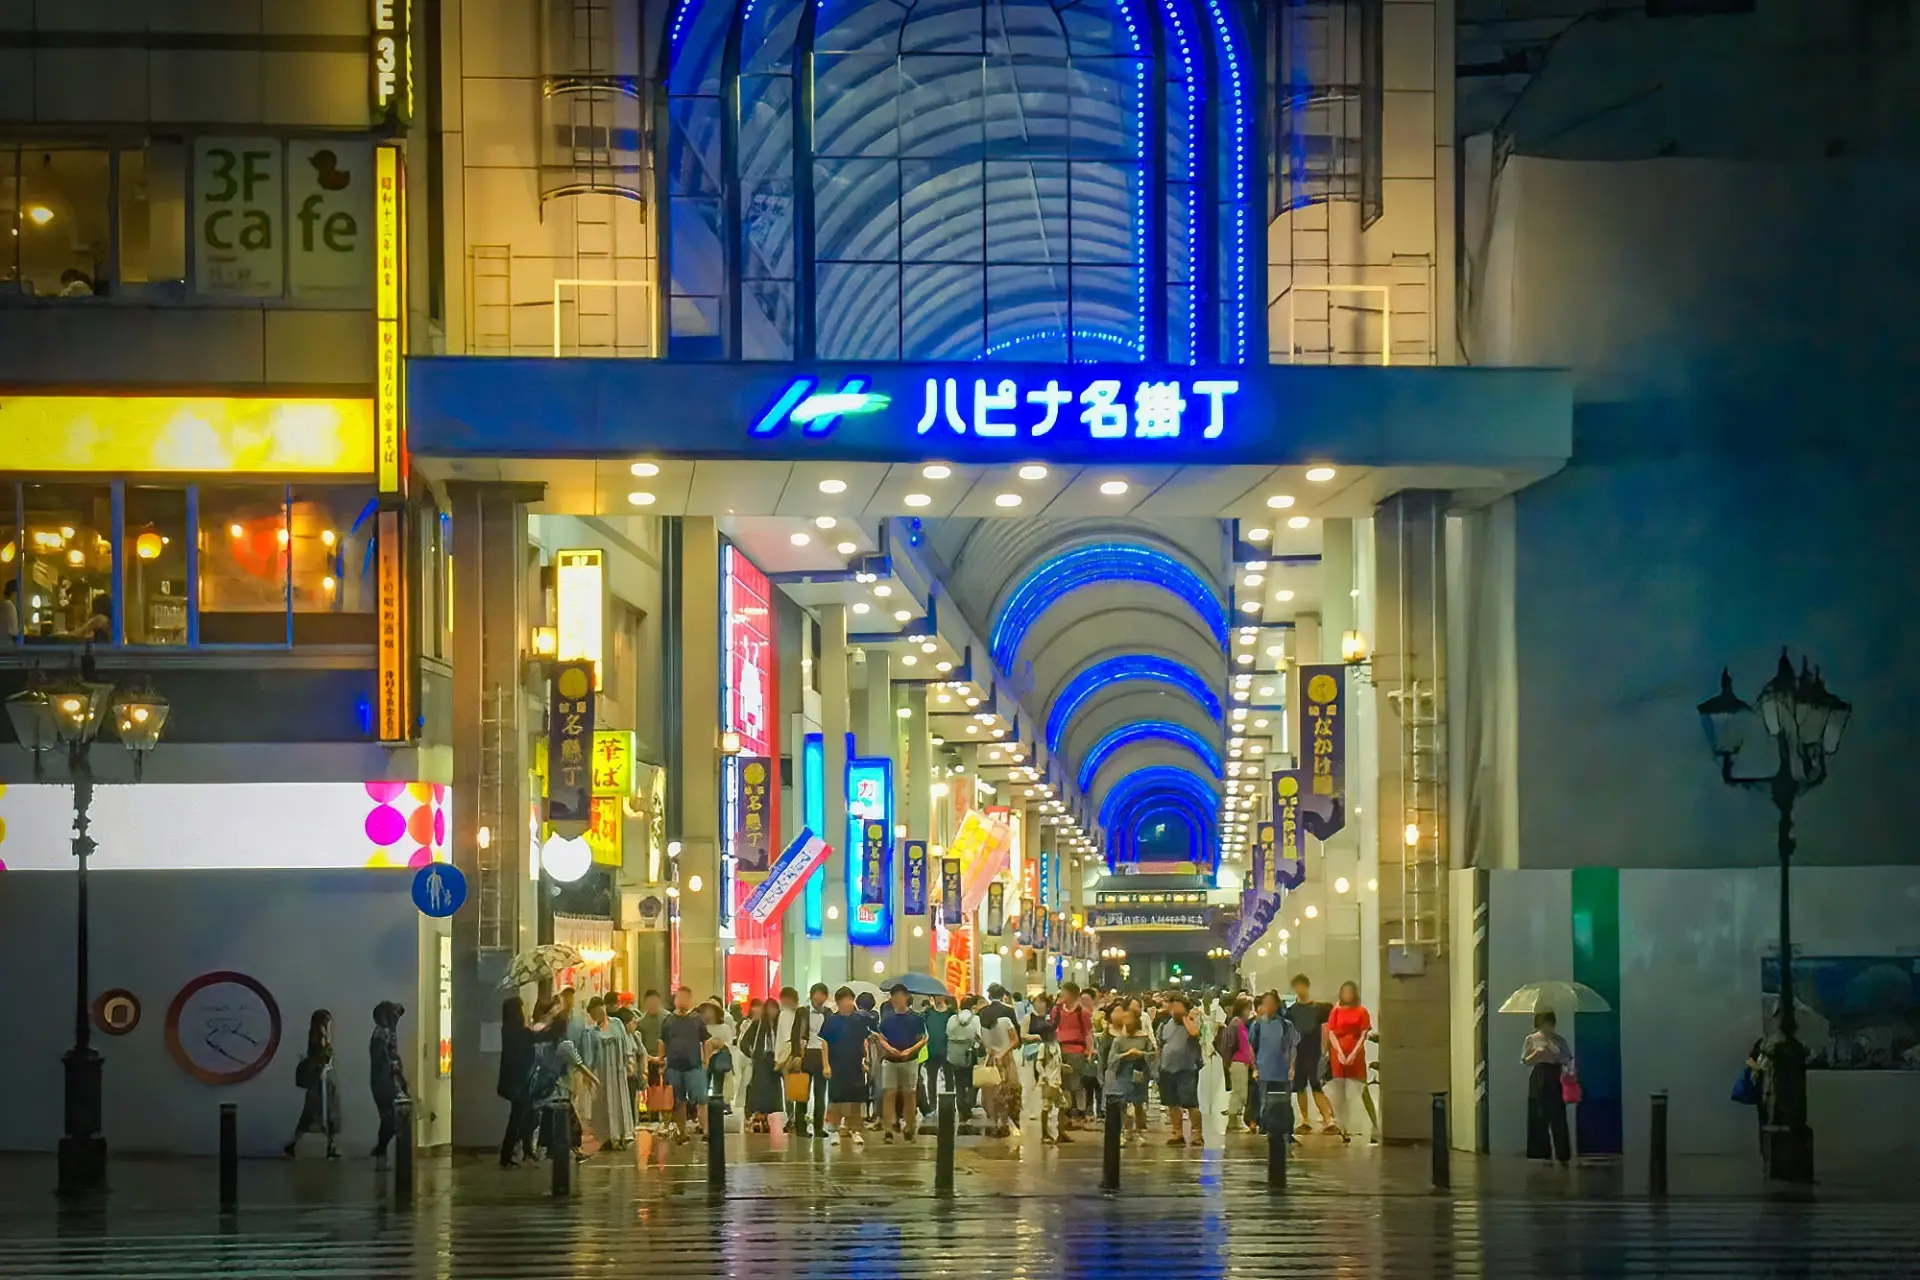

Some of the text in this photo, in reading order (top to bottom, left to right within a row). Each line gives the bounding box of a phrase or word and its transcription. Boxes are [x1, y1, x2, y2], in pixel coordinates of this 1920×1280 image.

[377, 37, 396, 106] 3F
[205, 148, 271, 203] 3F
[917, 378, 1240, 439] ハピナ名掛丁
[594, 764, 622, 787] ば
[595, 737, 624, 762] 華
